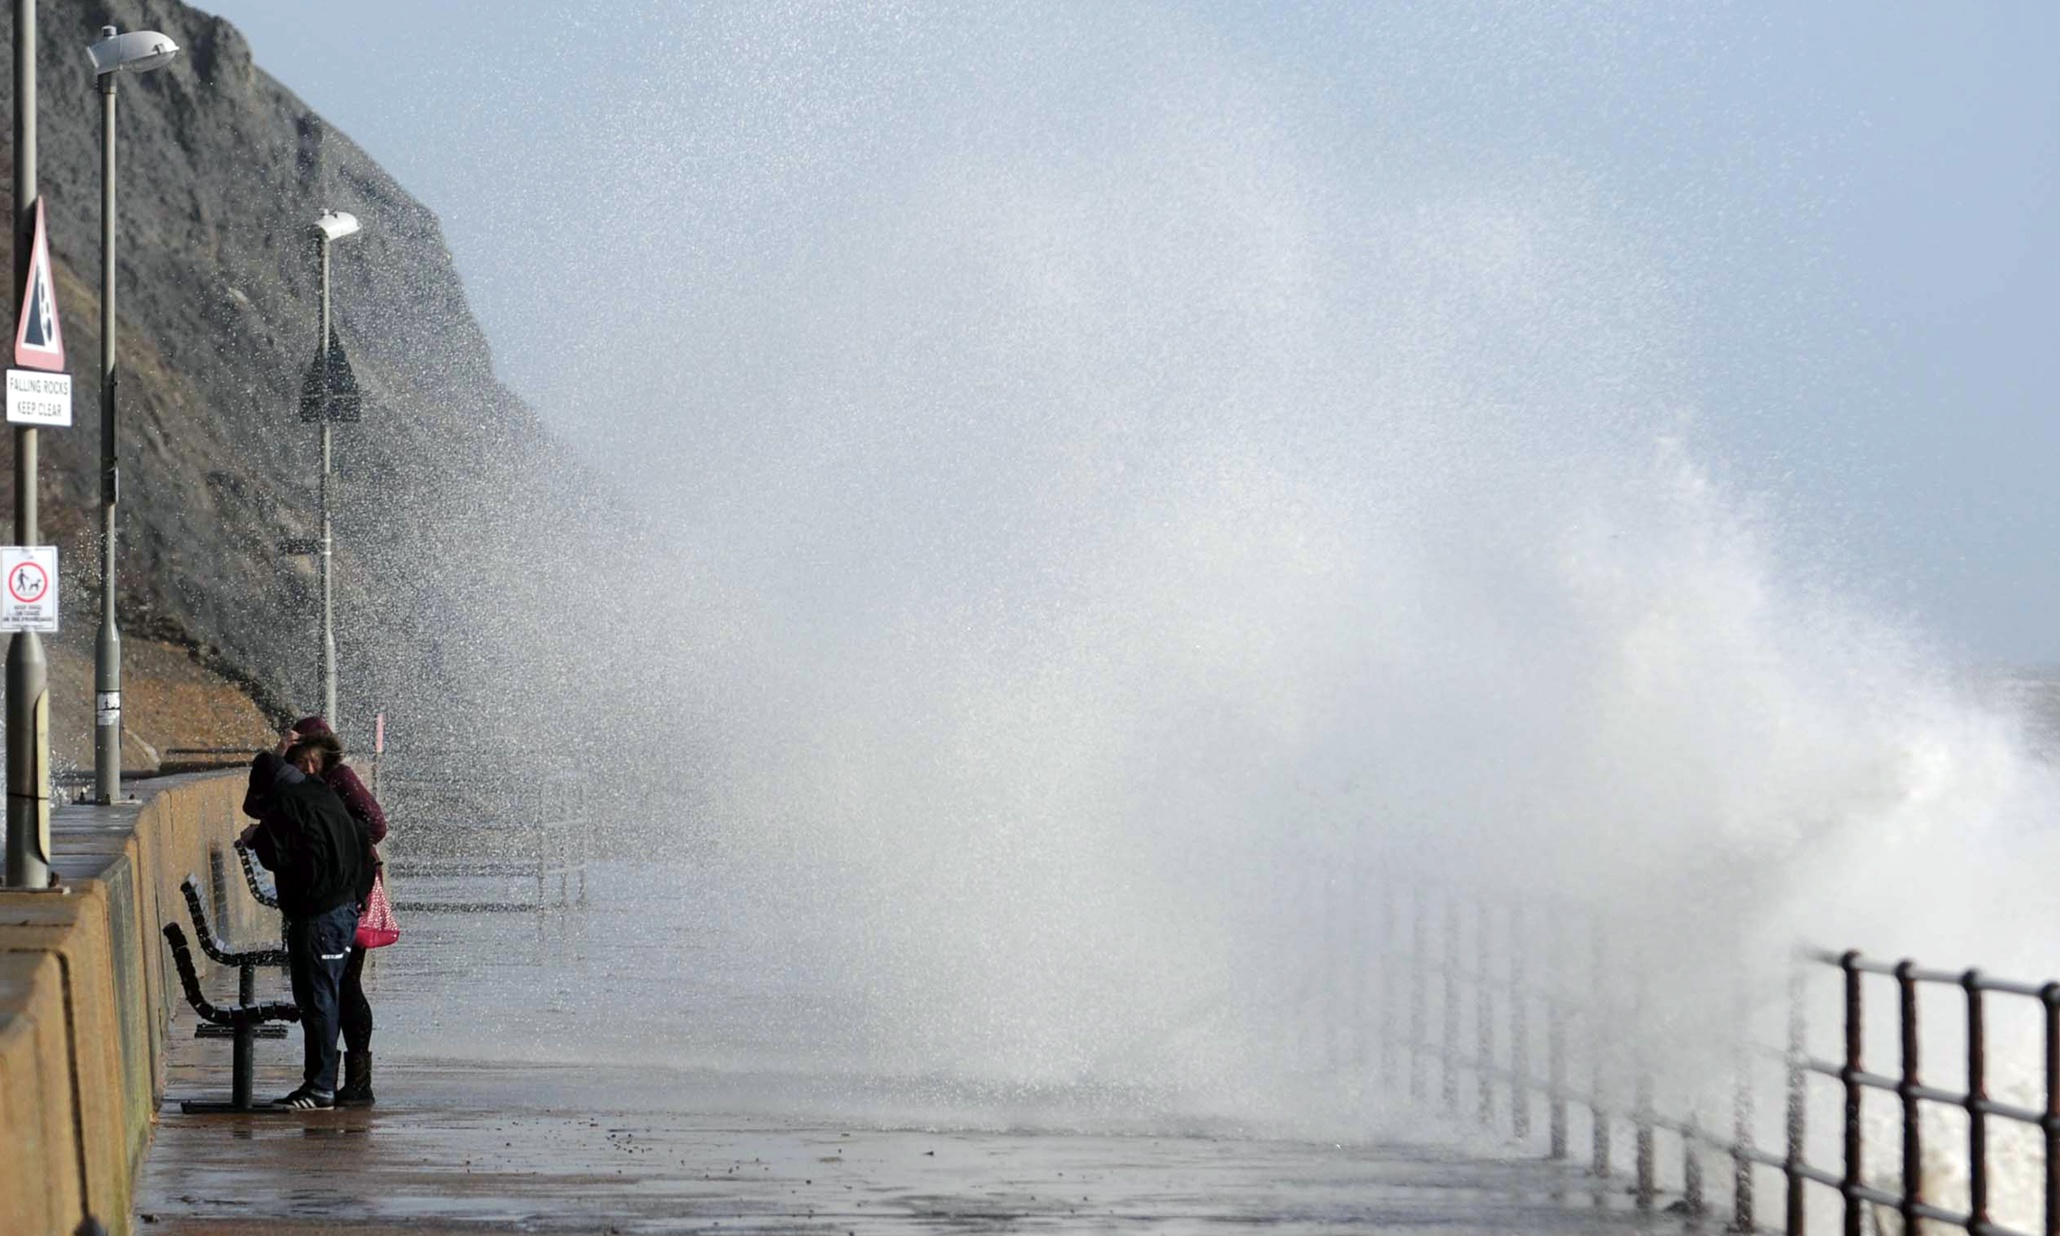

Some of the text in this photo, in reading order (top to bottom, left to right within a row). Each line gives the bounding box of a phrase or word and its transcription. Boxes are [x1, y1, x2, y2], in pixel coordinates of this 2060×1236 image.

[10, 377, 69, 395] FALLING ROCKS
[17, 401, 62, 417] KEEP CLEAR
